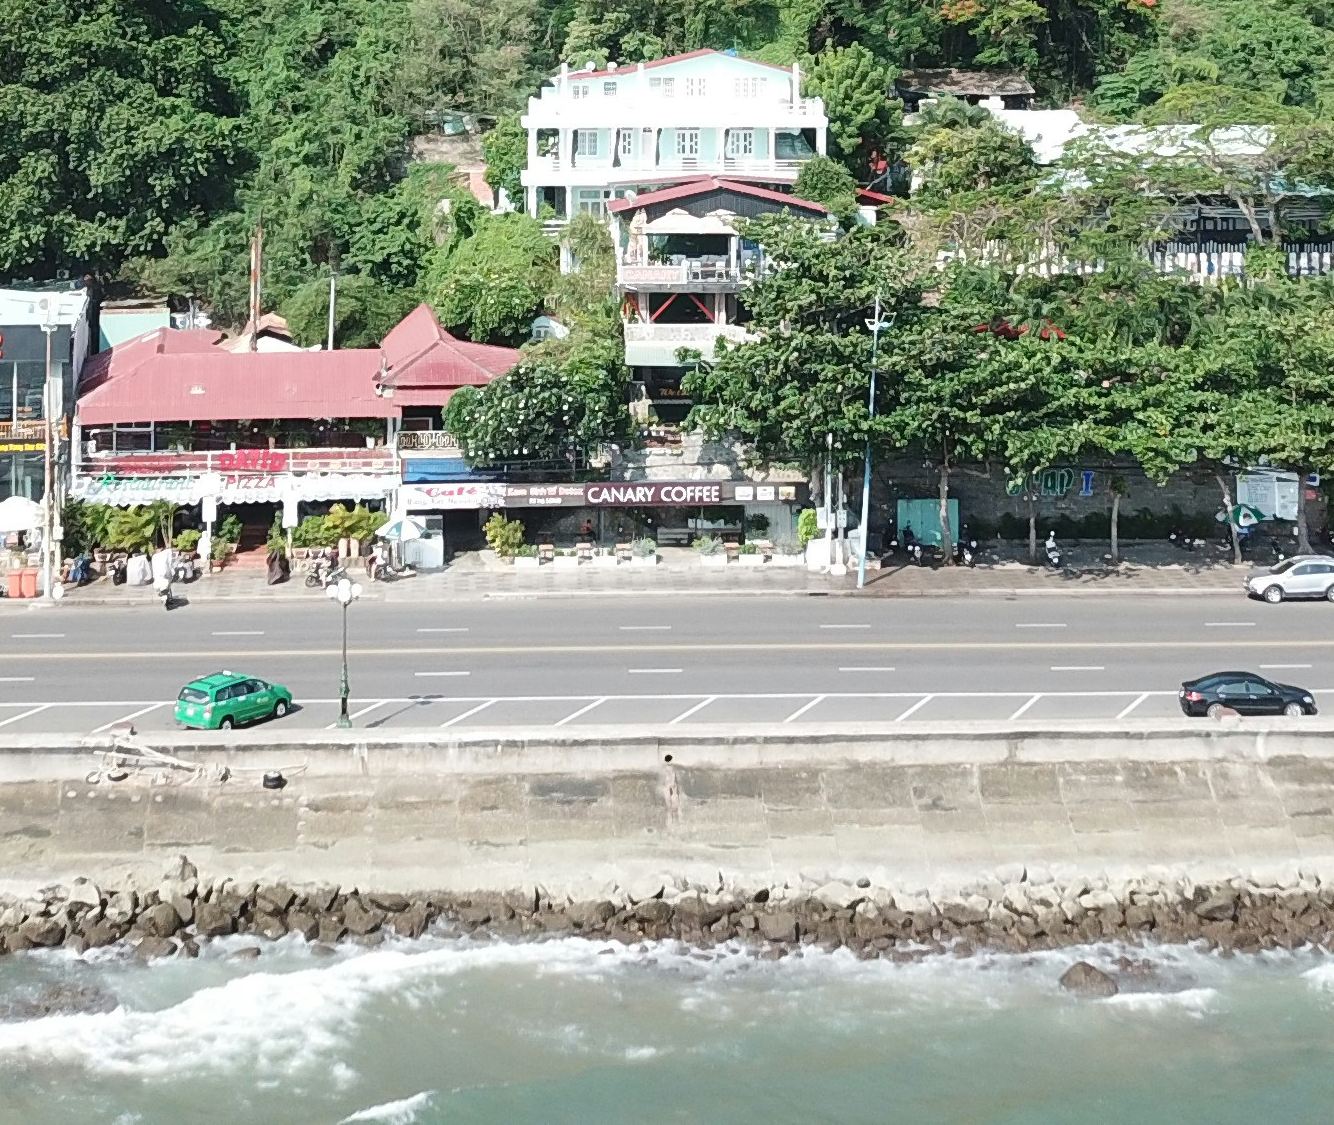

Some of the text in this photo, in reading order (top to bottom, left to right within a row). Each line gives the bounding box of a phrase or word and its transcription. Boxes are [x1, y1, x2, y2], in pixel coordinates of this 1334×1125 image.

[219, 449, 287, 471] DAVID
[224, 475, 276, 489] PIZZA
[587, 485, 720, 504] CANARY COFFEE
